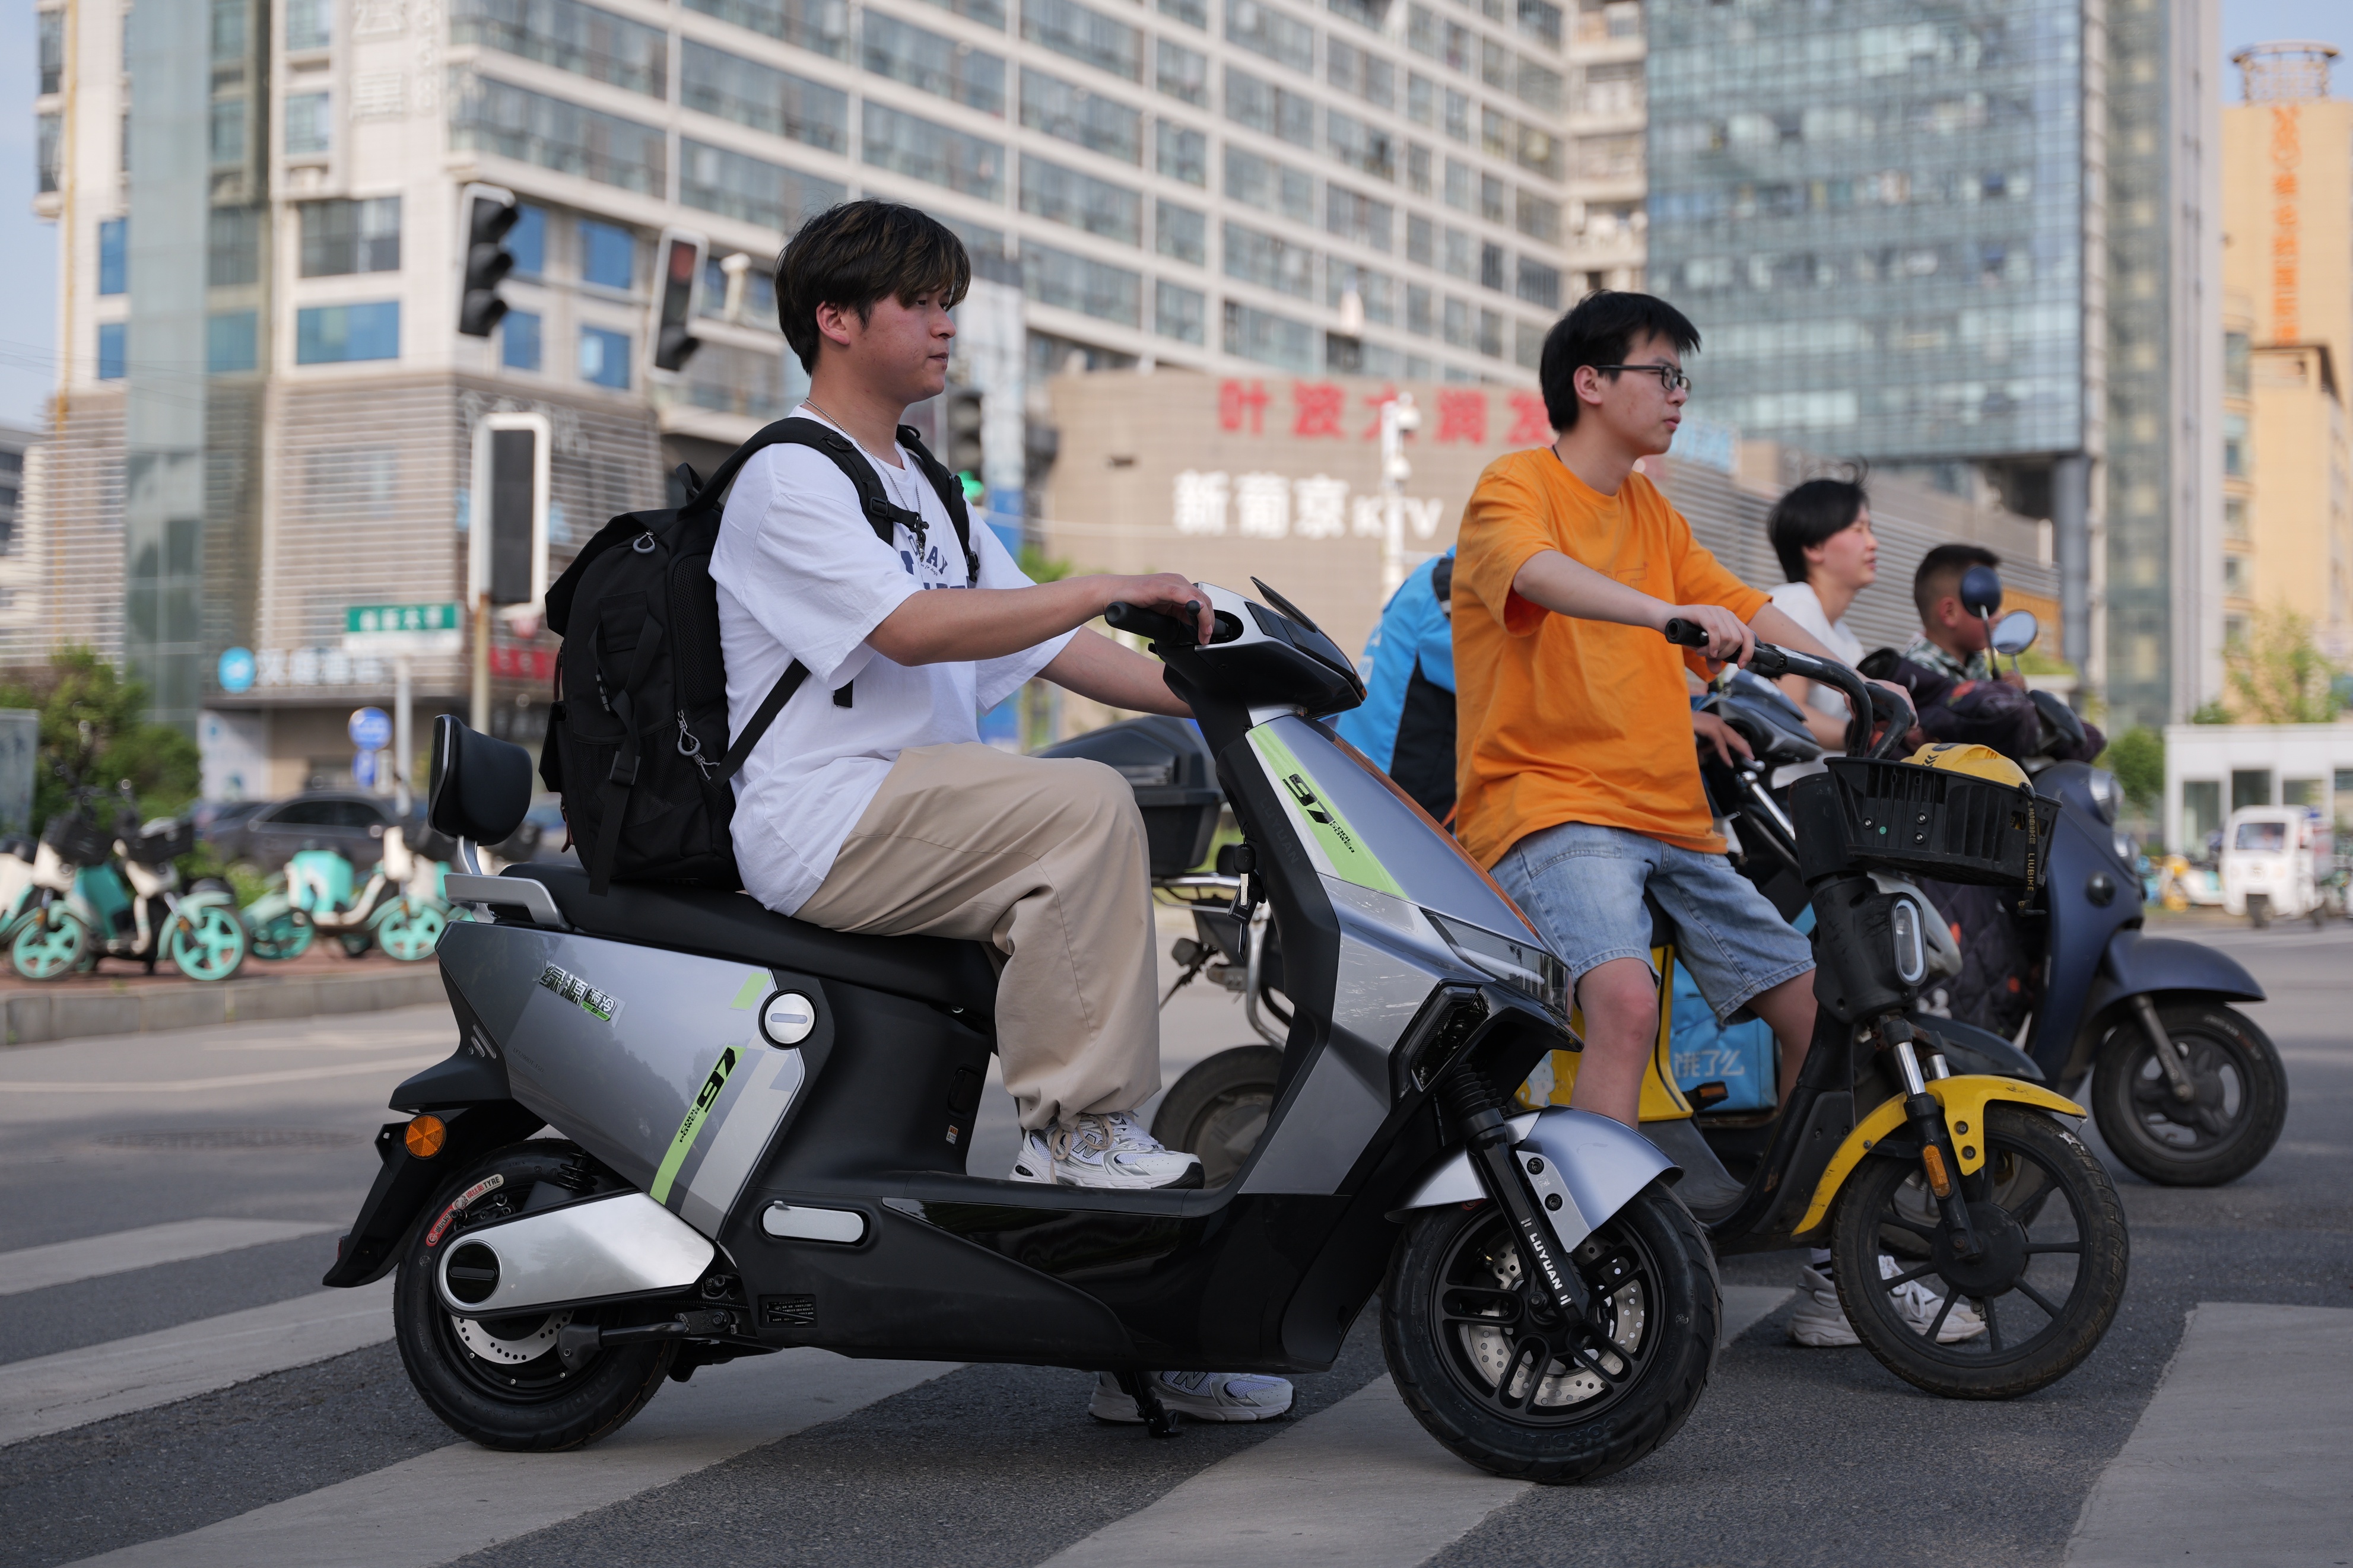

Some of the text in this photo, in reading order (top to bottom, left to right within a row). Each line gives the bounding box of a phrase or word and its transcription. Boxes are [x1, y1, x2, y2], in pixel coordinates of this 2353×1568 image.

[1282, 773, 1335, 824] 97
[1329, 823, 1355, 853] POWER
[1332, 820, 1352, 845] COOL
[539, 964, 589, 1006] 绿源
[1674, 1049, 1745, 1078] 饿了么
[697, 1047, 736, 1114] 97
[679, 1107, 701, 1143] POWER
[680, 1105, 699, 1134] COOL
[466, 1183, 484, 1199] 钢丝胎
[482, 1176, 500, 1189] TYRE
[1529, 1233, 1563, 1290] LUYUAN
